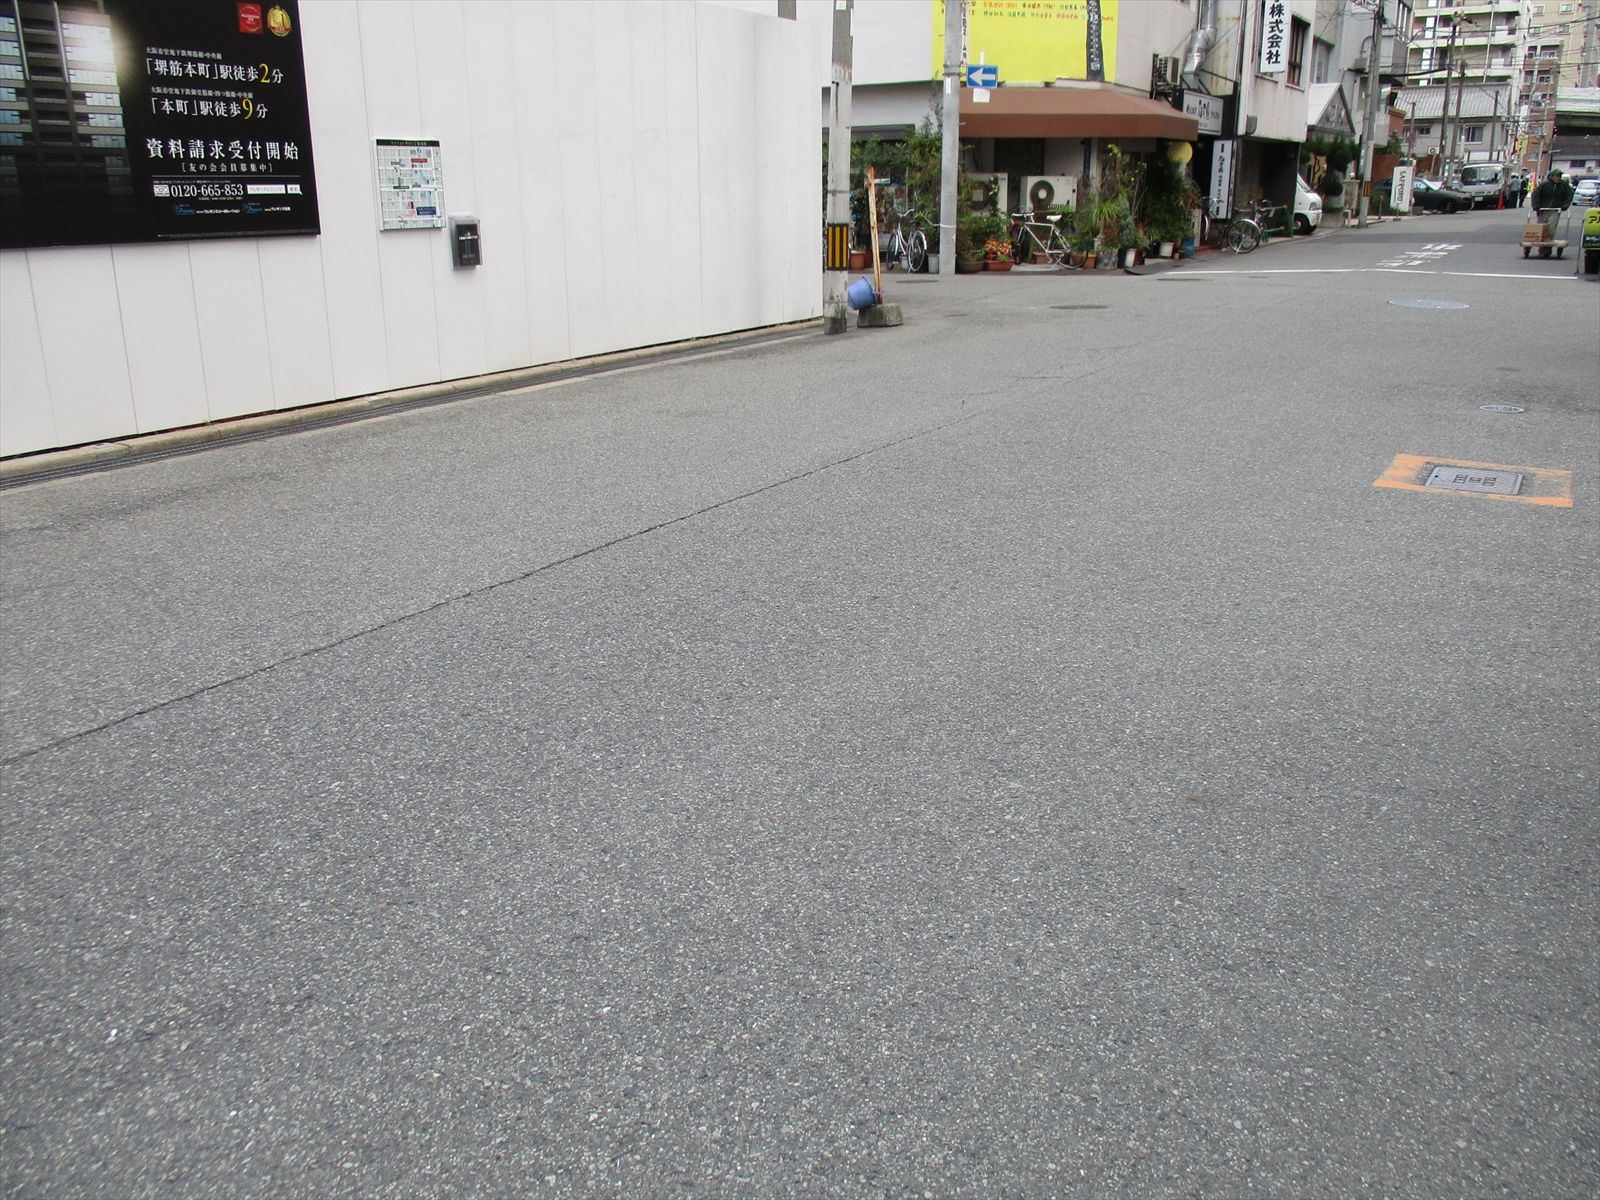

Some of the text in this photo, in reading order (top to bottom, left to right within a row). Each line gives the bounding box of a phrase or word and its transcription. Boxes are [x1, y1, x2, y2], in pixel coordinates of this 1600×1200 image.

[1265, 0, 1285, 65] 株式会社
[151, 97, 268, 119] 「本町」駅徒歩9分
[146, 138, 299, 160] 資料請求受付開始
[171, 184, 244, 198] 0120-665-853
[1396, 170, 1406, 202] SAPPORO
